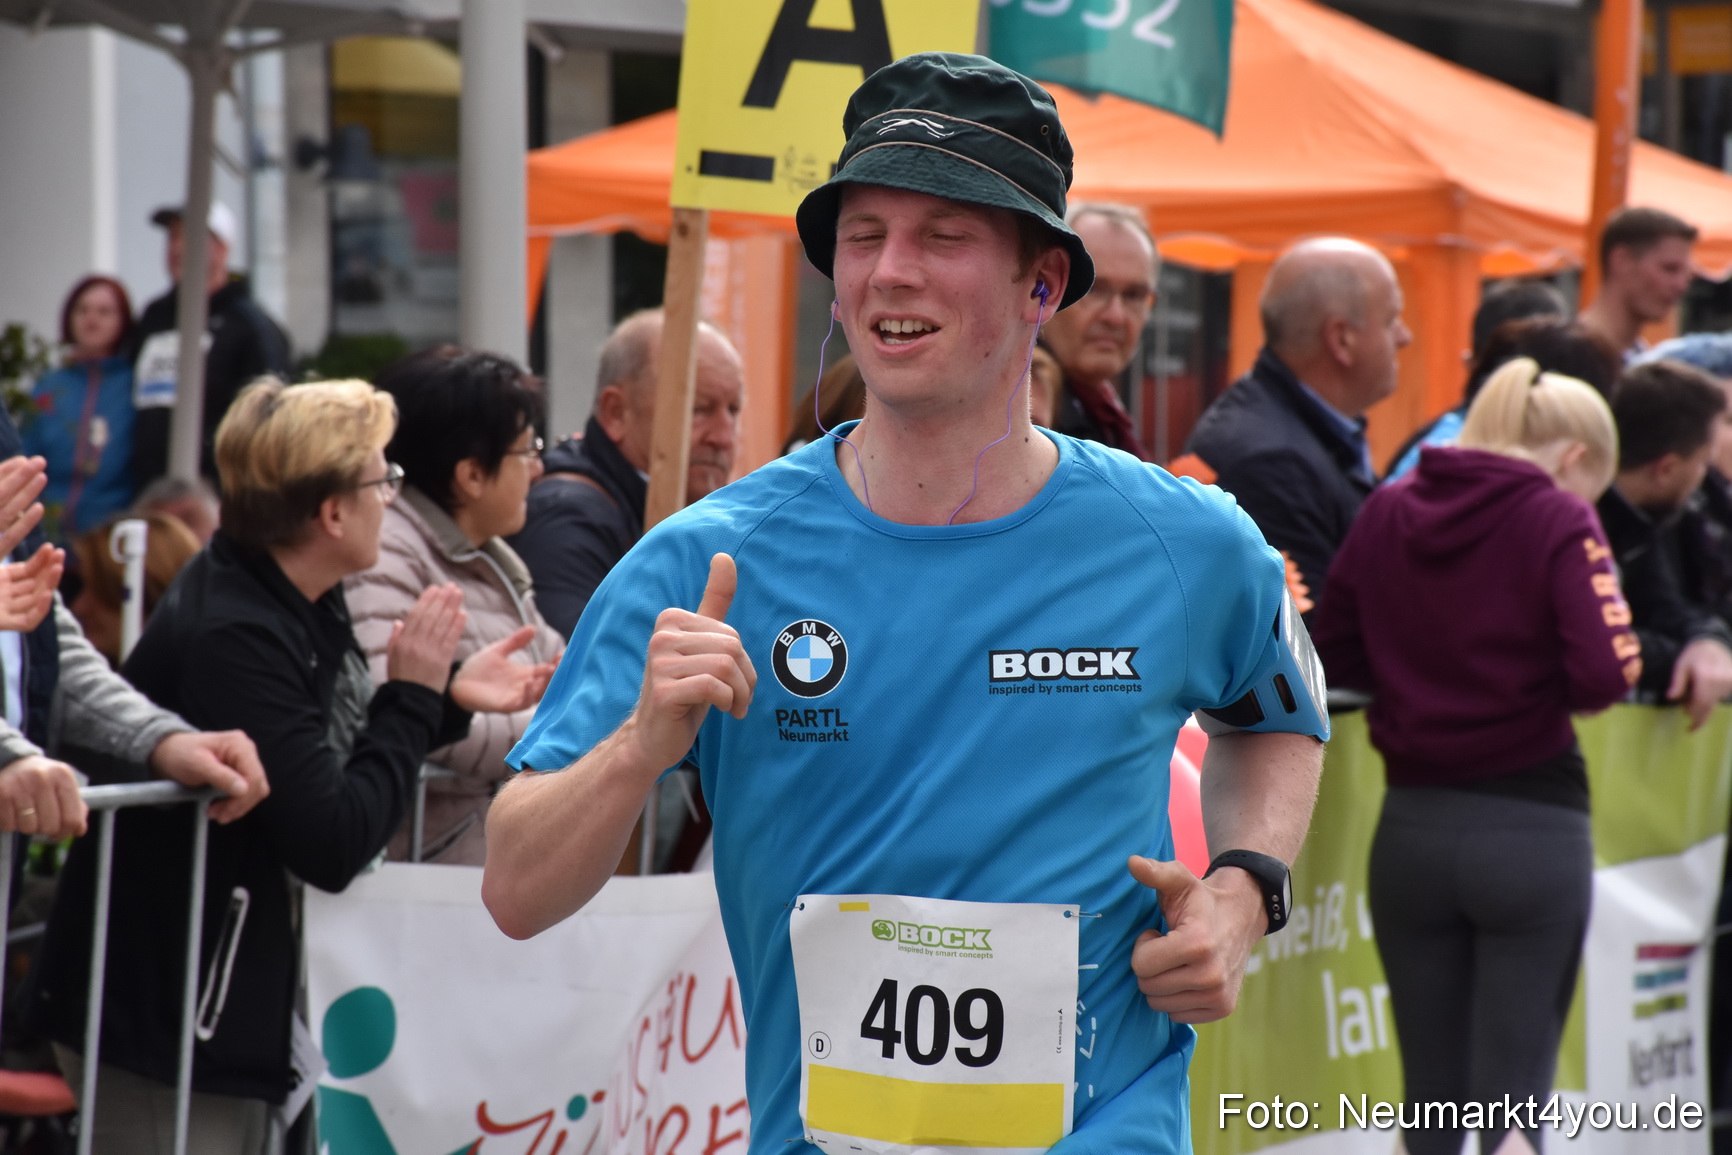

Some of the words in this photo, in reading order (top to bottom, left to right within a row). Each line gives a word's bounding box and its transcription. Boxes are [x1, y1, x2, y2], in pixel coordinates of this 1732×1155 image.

[741, 0, 893, 109] A
[779, 622, 841, 647] BMW
[989, 647, 1141, 682] BOCK
[989, 684, 1035, 696] inspired
[1038, 683, 1053, 695] by
[1056, 683, 1089, 693] smart
[1093, 683, 1142, 694] concepts
[775, 708, 848, 727] PARTL
[779, 728, 849, 742] Neumarkt
[898, 921, 992, 950] BOCK
[898, 944, 924, 954] inspired
[925, 948, 934, 957] by
[935, 950, 957, 958] smart
[959, 951, 993, 960] concepts
[860, 978, 1004, 1067] 409
[815, 1038, 824, 1053] D
